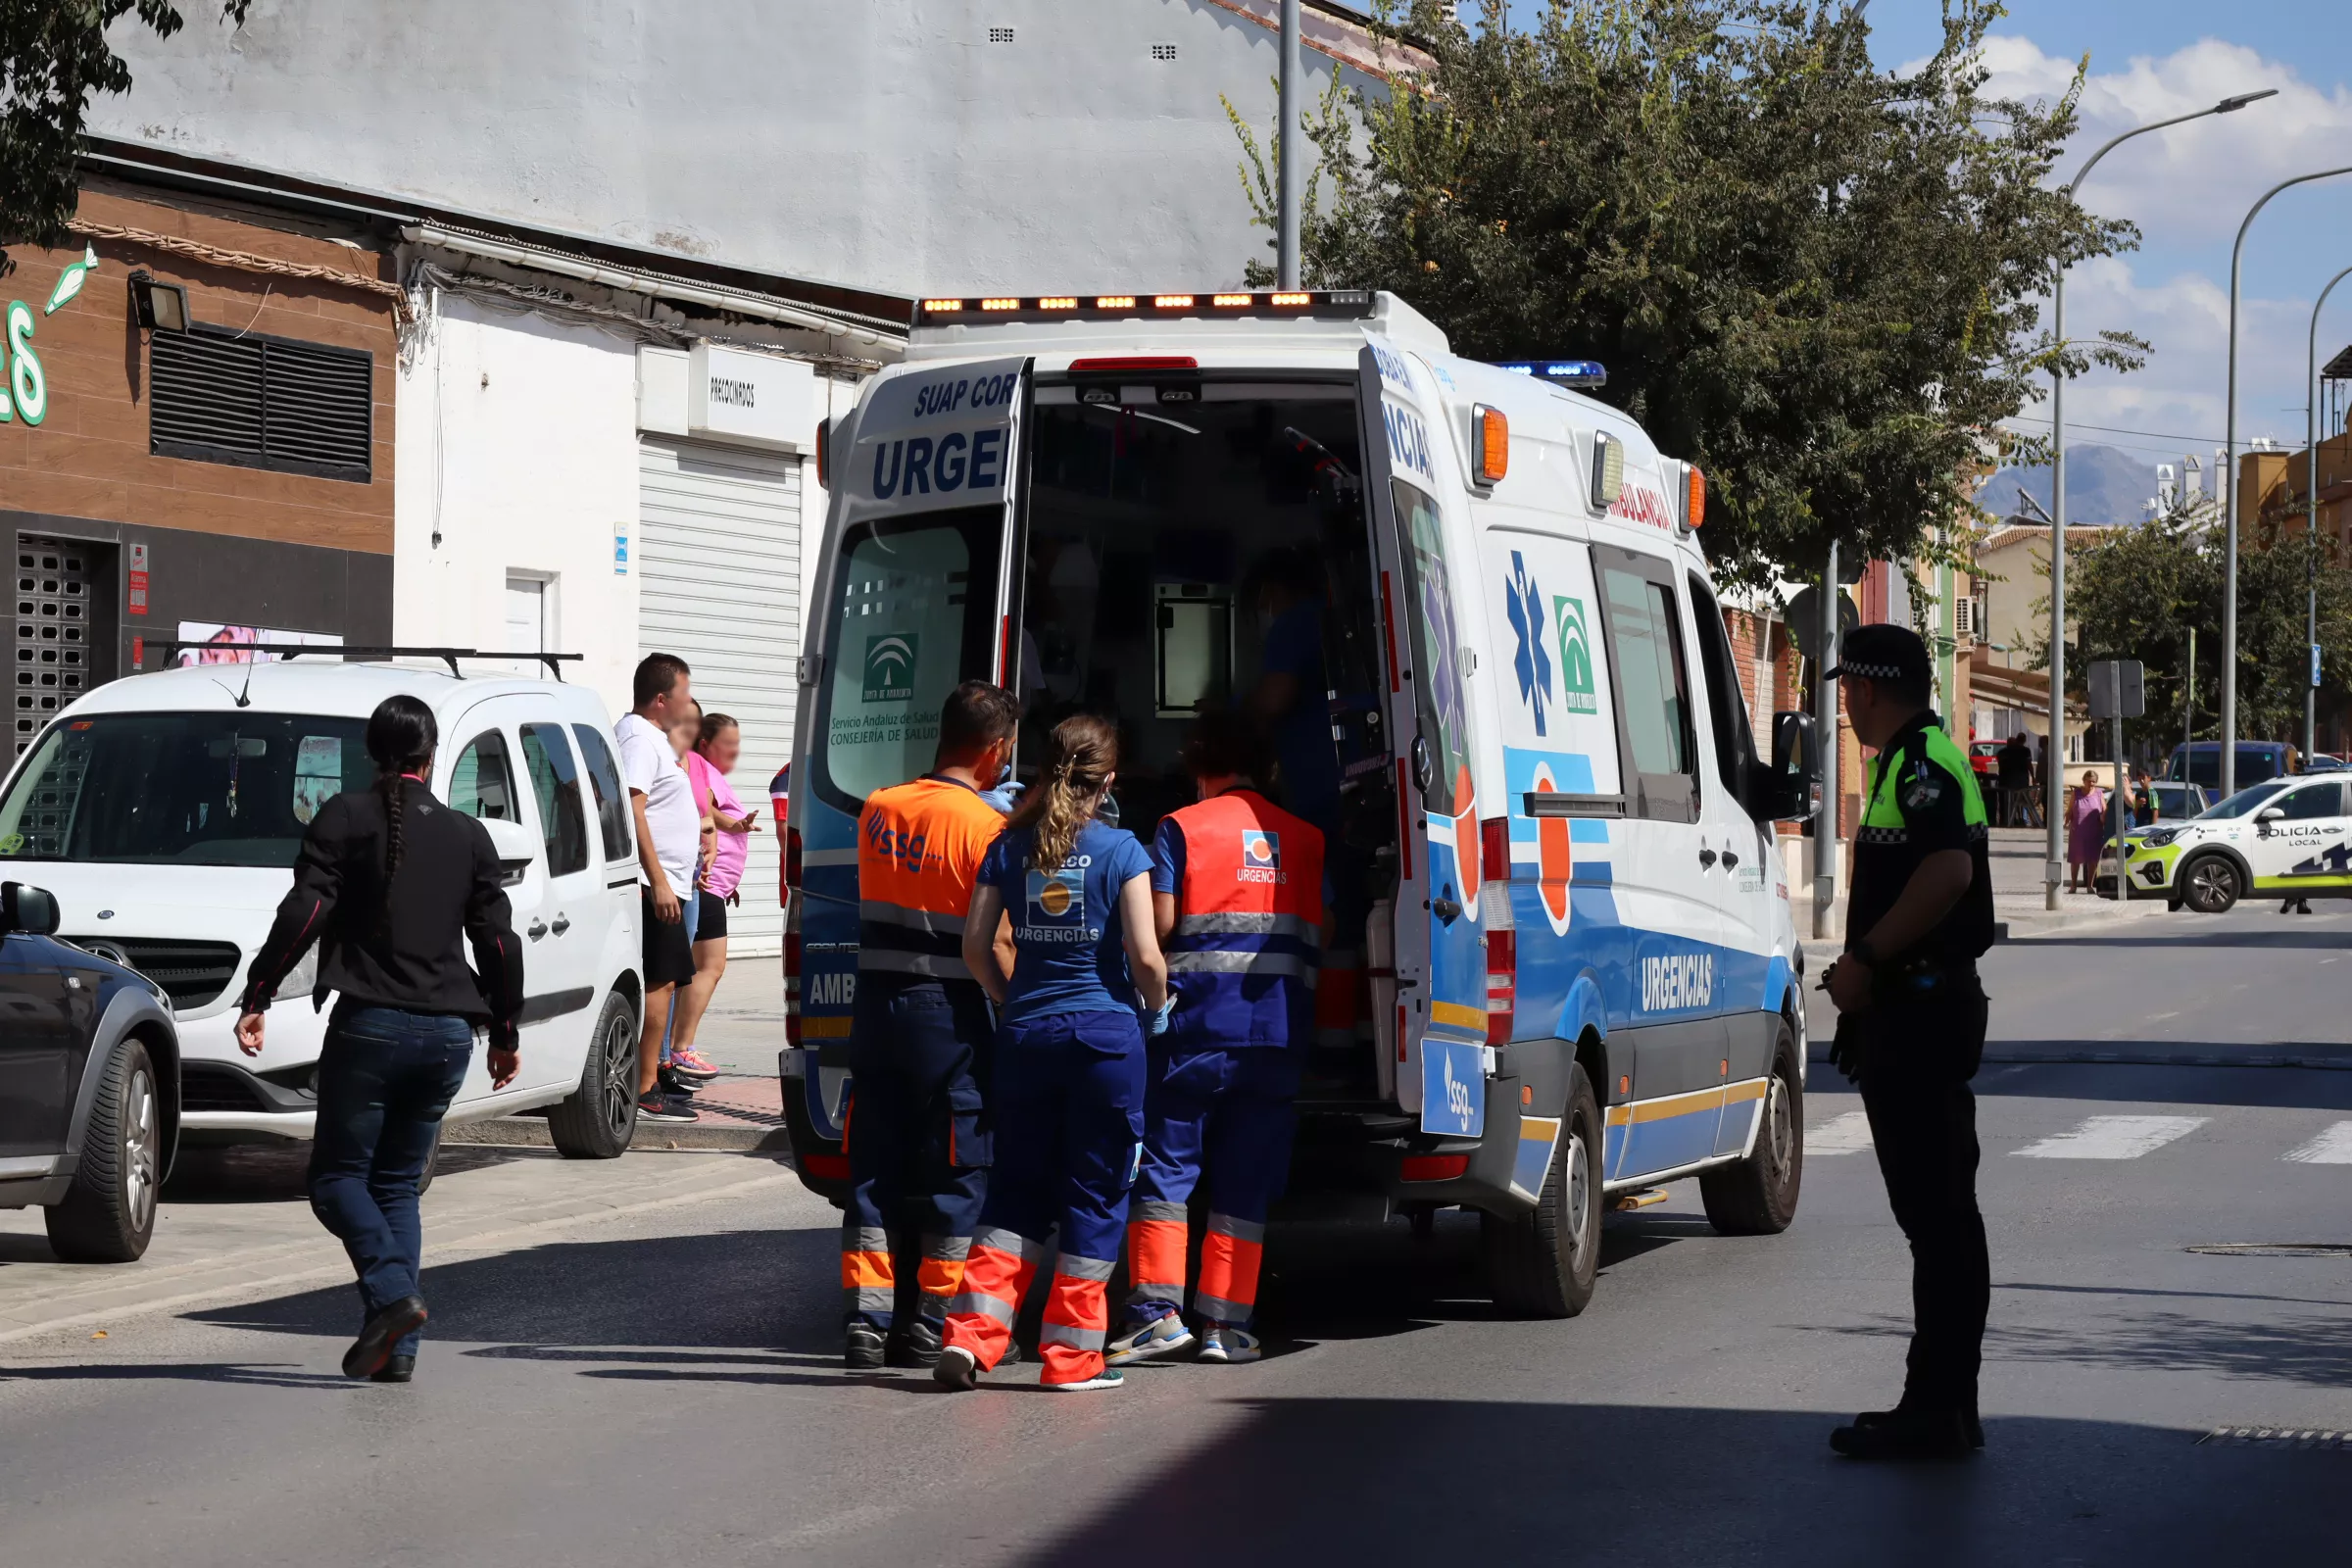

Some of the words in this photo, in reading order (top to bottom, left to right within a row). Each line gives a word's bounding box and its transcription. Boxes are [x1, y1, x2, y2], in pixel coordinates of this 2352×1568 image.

[710, 376, 755, 409] PRECOCINADOS
[913, 379, 968, 417] SUAP
[872, 428, 1011, 500] URGE
[832, 715, 861, 729] Servicio
[862, 713, 898, 726] Andaluz
[900, 712, 912, 724] de
[913, 710, 939, 723] Salud
[830, 727, 884, 745] CONSEJERÍA
[888, 729, 901, 742] DE
[905, 727, 939, 741] SALUD
[2256, 824, 2322, 838] POLICÍA
[1237, 868, 1287, 885] URGENCIAS
[1015, 927, 1100, 942] URGENCIAS
[1642, 953, 1712, 1012] URGENCIAS
